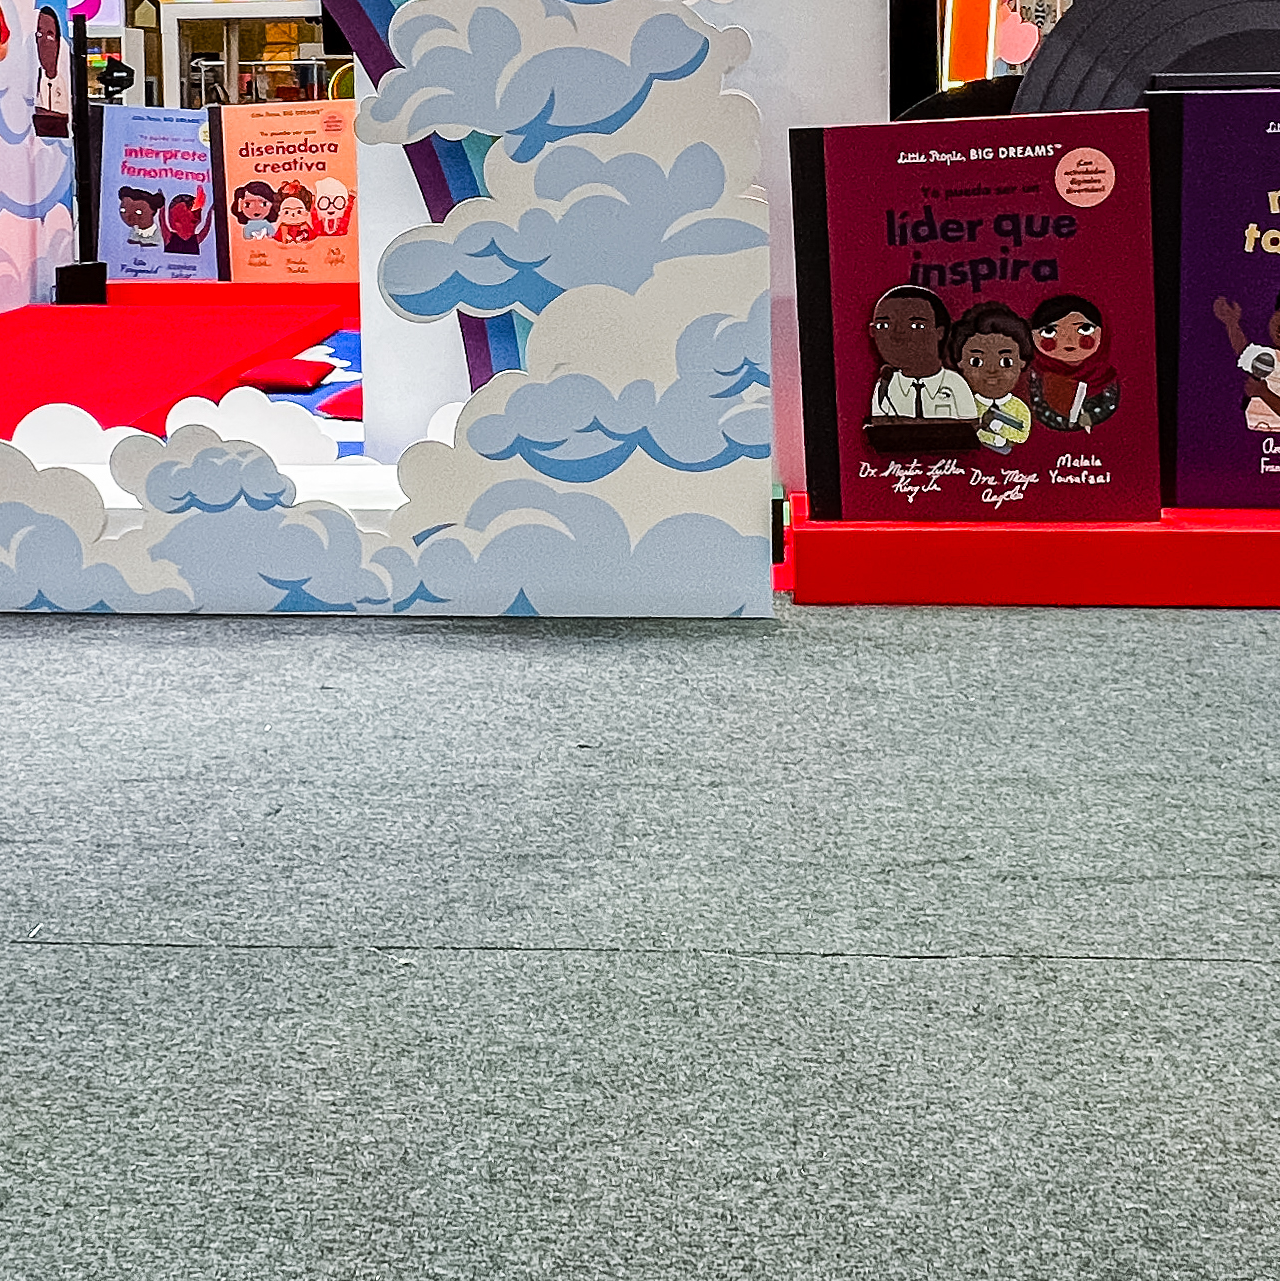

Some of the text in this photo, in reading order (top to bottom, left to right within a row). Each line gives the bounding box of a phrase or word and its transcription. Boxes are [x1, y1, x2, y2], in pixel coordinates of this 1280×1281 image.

[238, 137, 339, 158] diseñadora
[897, 151, 927, 164] Little
[969, 148, 994, 160] BIG
[121, 160, 210, 183] fenomenal
[254, 157, 326, 173] creativa
[921, 183, 1039, 200] Yo puedo ser un
[886, 205, 1077, 247] líder que
[909, 246, 1059, 294] inspira
[1056, 453, 1102, 468] Malala
